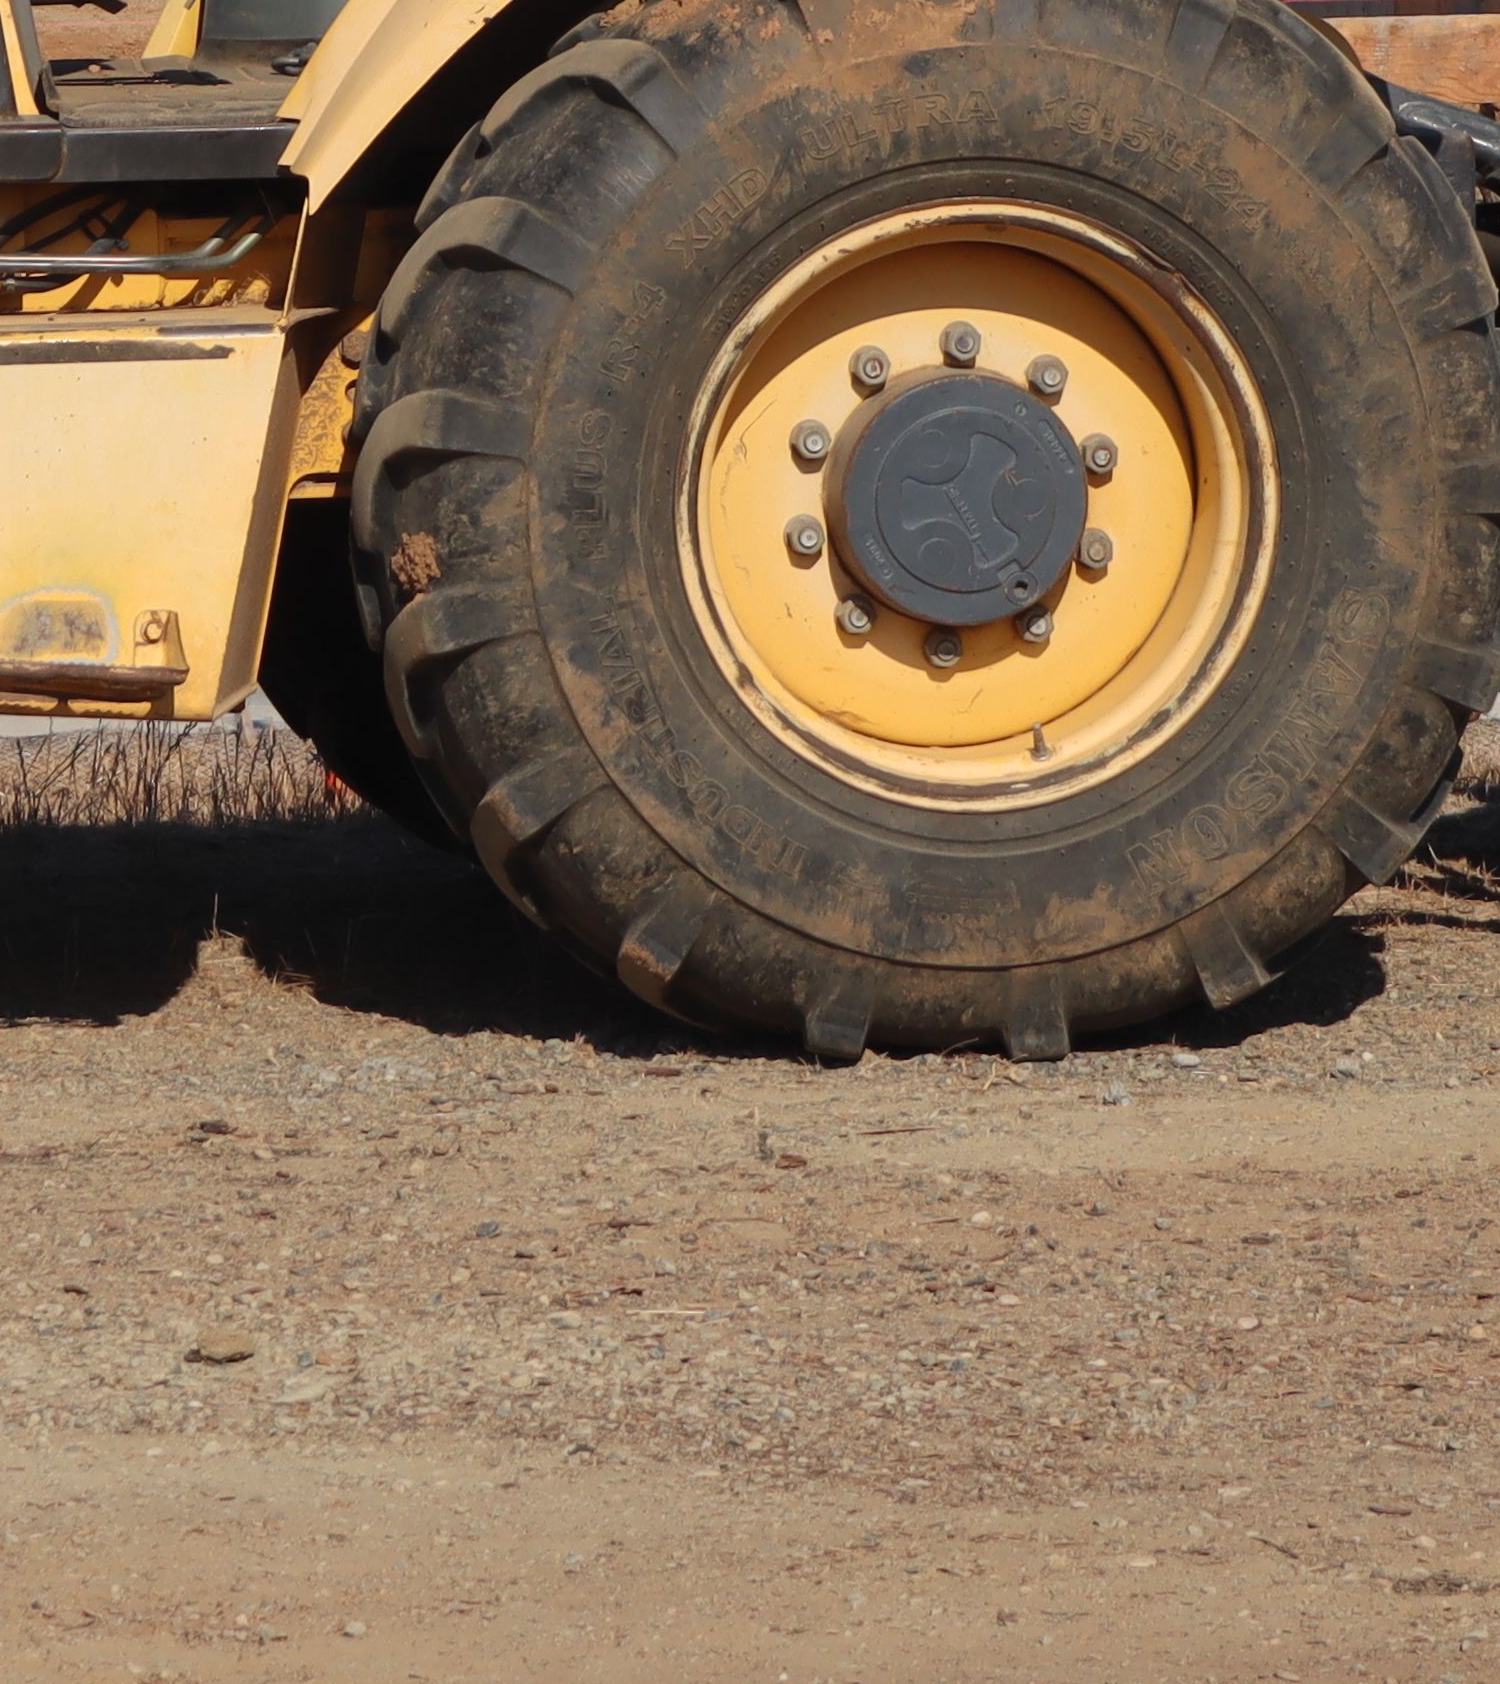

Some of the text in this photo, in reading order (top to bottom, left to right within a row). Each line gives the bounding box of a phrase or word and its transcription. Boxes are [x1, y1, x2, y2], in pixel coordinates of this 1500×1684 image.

[664, 168, 771, 268] XHD
[800, 90, 998, 160] ULTRA
[1125, 586, 1391, 892] SAMSON
